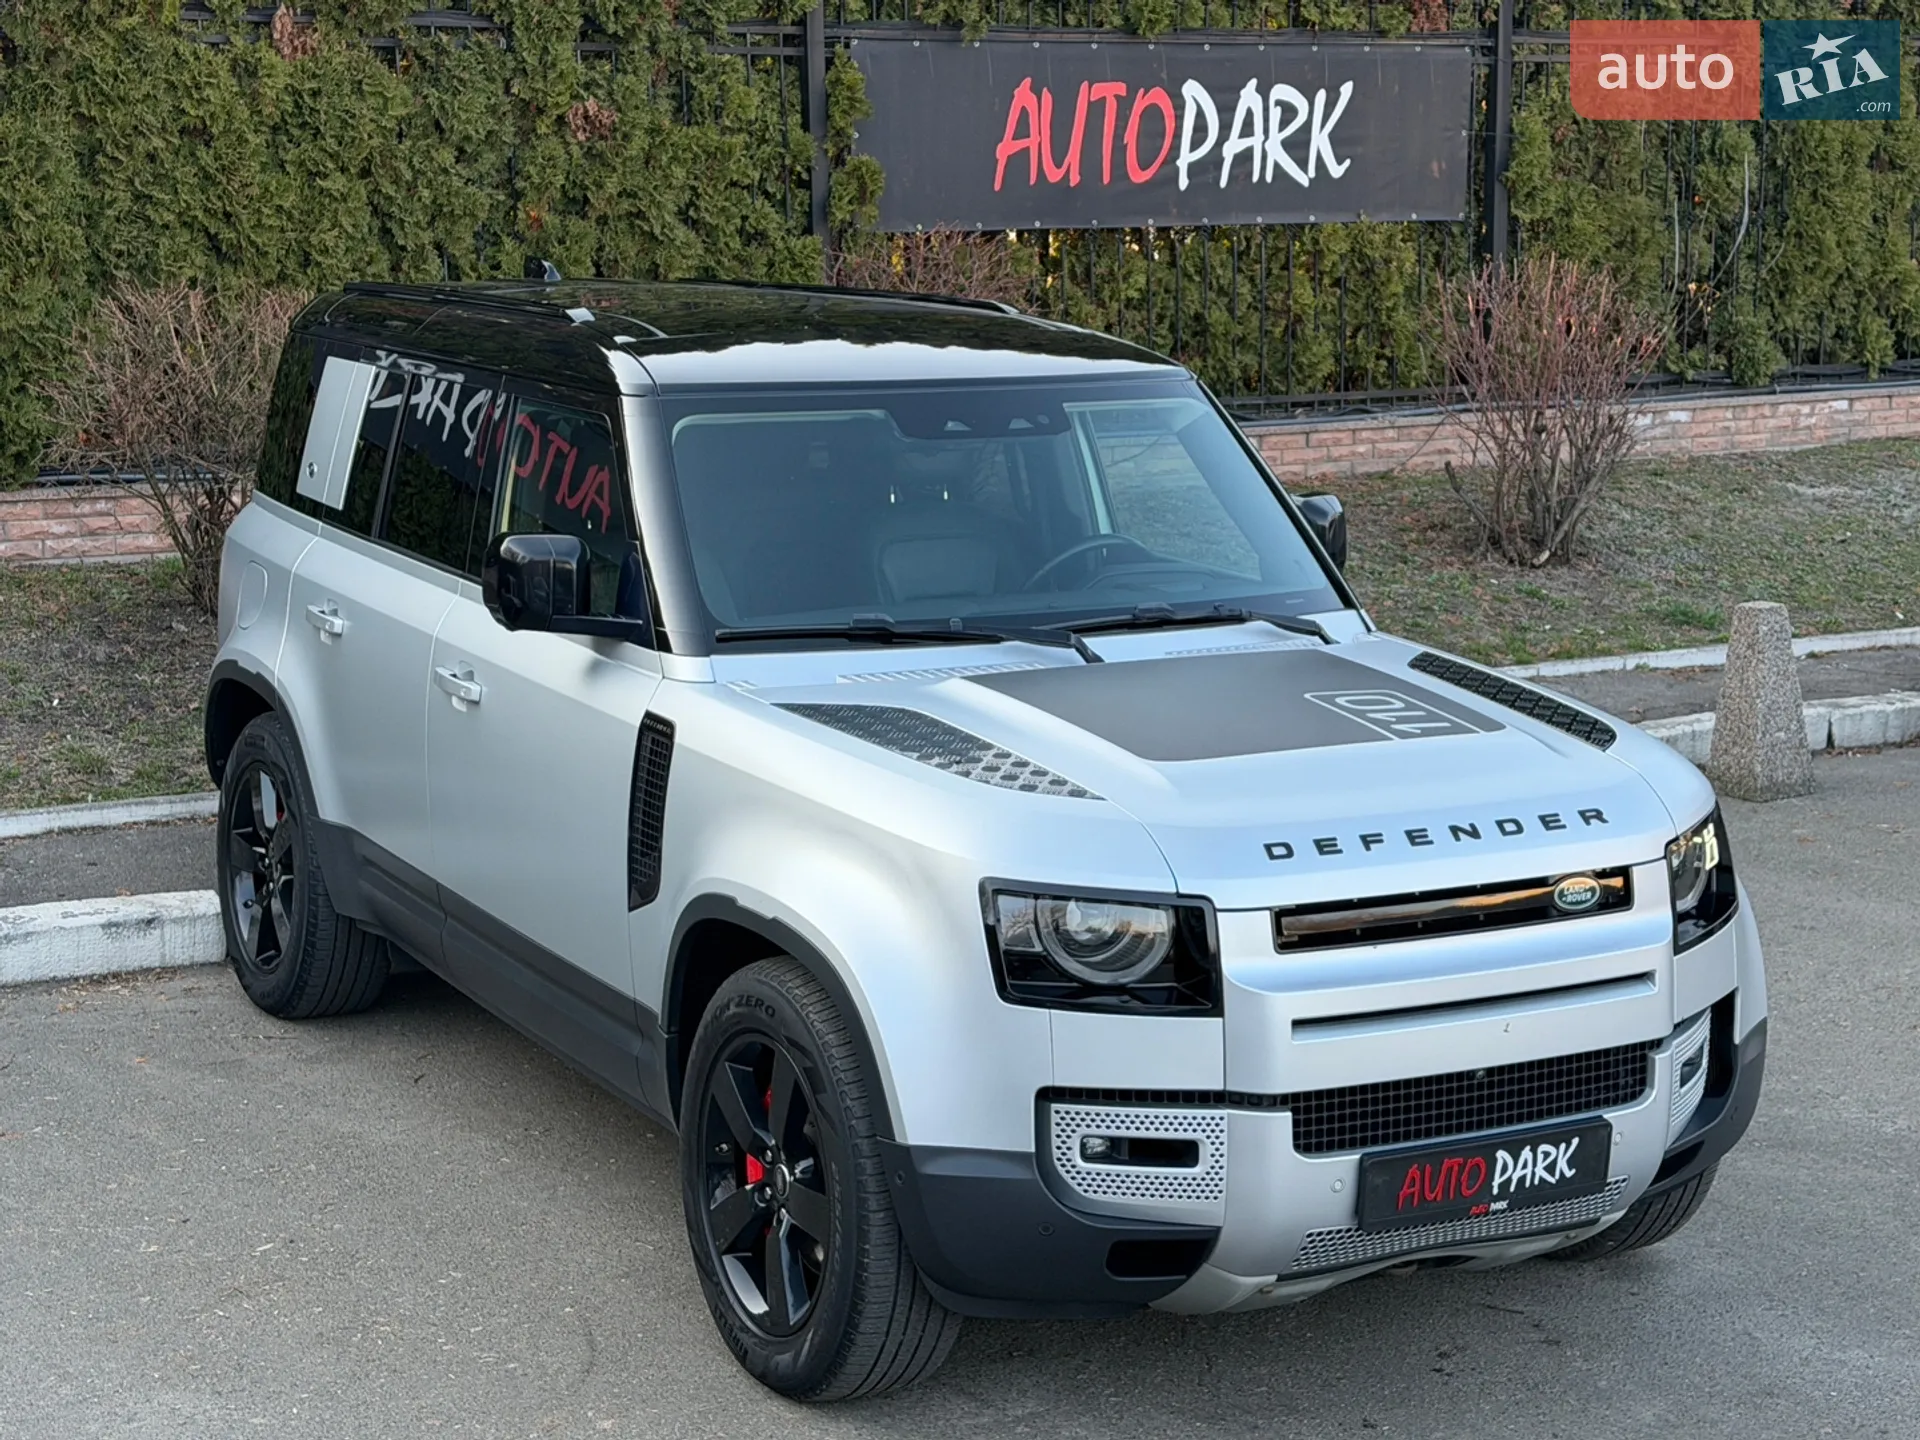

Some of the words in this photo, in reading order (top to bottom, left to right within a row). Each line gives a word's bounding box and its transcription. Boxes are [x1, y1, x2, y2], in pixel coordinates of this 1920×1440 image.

[1335, 695, 1452, 734] 110
[1263, 808, 1609, 860] DEFENDER
[1396, 1156, 1487, 1211] AUTO
[1492, 1136, 1580, 1195] PARK
